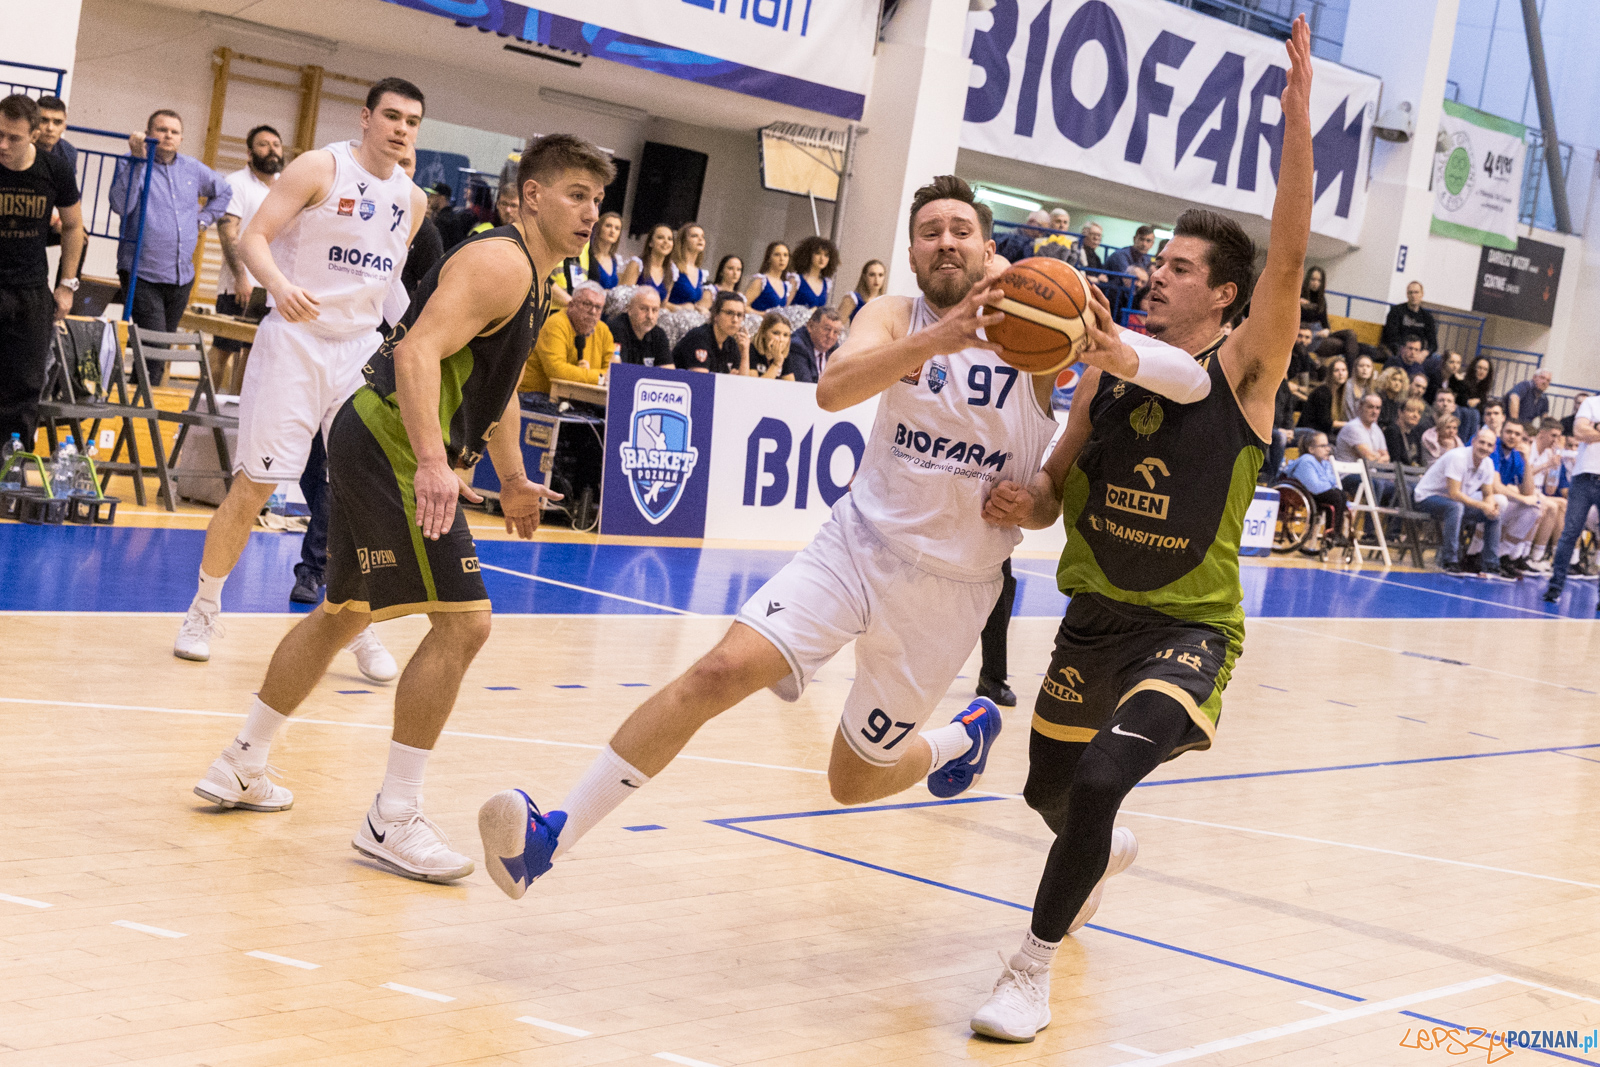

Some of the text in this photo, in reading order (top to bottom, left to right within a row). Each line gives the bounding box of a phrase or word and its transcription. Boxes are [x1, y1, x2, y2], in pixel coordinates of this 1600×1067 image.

[641, 390, 683, 404] BIOFARM
[967, 364, 1018, 409] 97
[624, 448, 695, 473] BASKET
[913, 456, 921, 466] o
[920, 459, 954, 474] zdrowie
[1107, 488, 1164, 515] ORLEN
[1105, 518, 1190, 549] TRANSITION
[1043, 675, 1079, 701] ORLEN
[861, 708, 916, 750] 97
